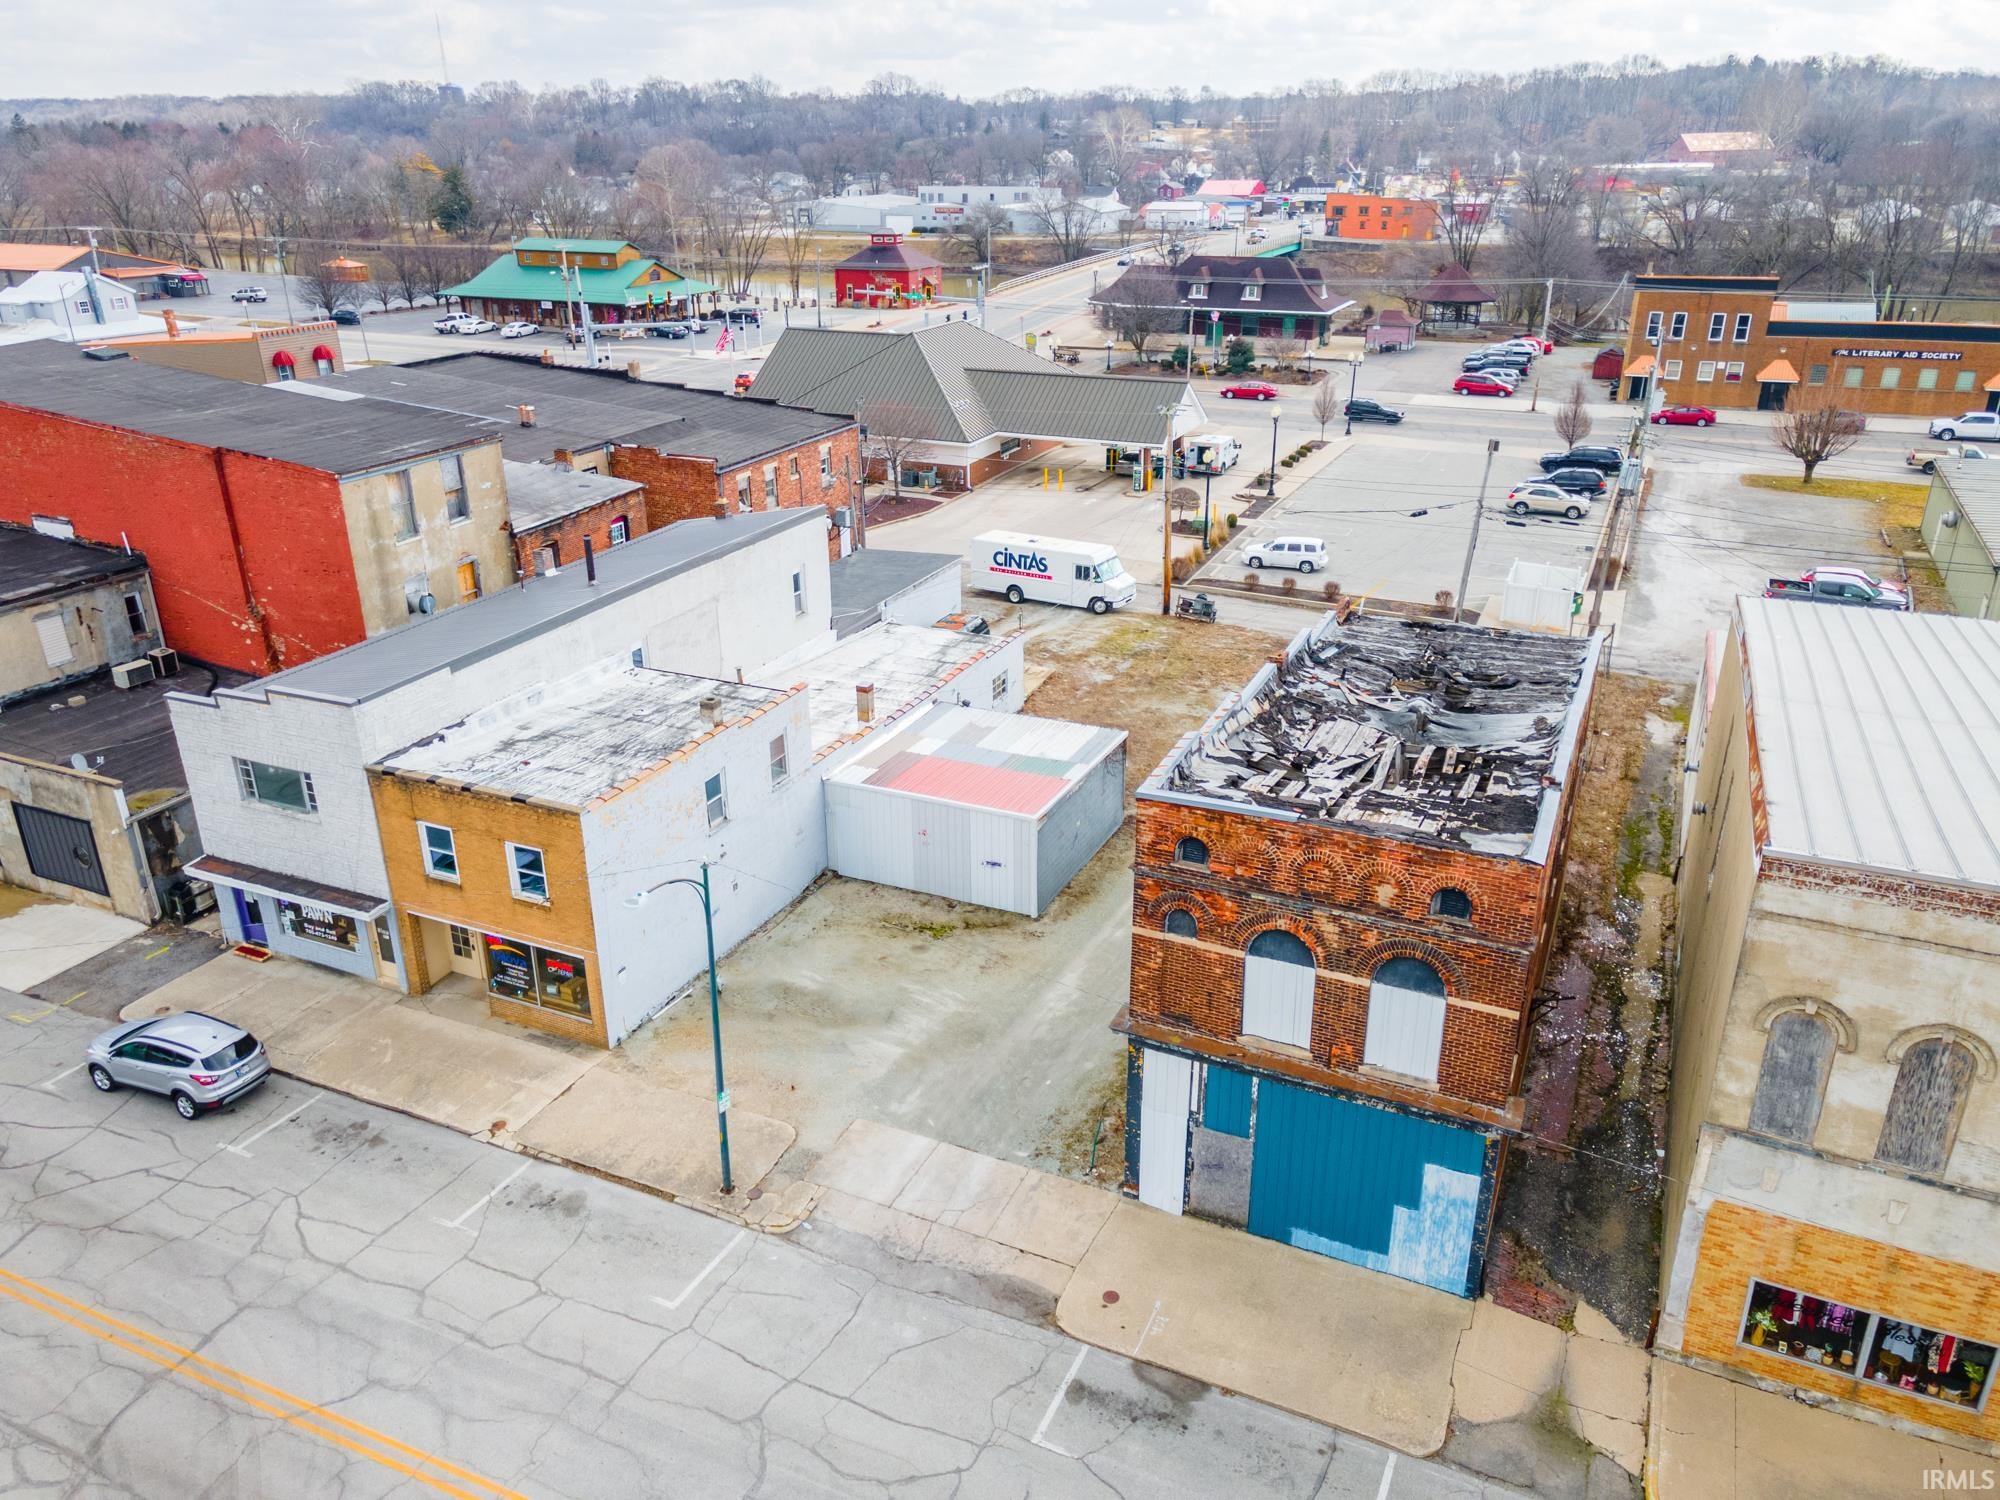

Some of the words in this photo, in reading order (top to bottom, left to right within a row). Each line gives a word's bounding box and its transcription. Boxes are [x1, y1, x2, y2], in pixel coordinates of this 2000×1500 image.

[1852, 349, 1899, 358] LITERARY
[1903, 351, 1918, 359] AID
[1921, 352, 1961, 360] SOCIETY
[993, 547, 1048, 573] CINTAS
[301, 904, 334, 924] PAWN
